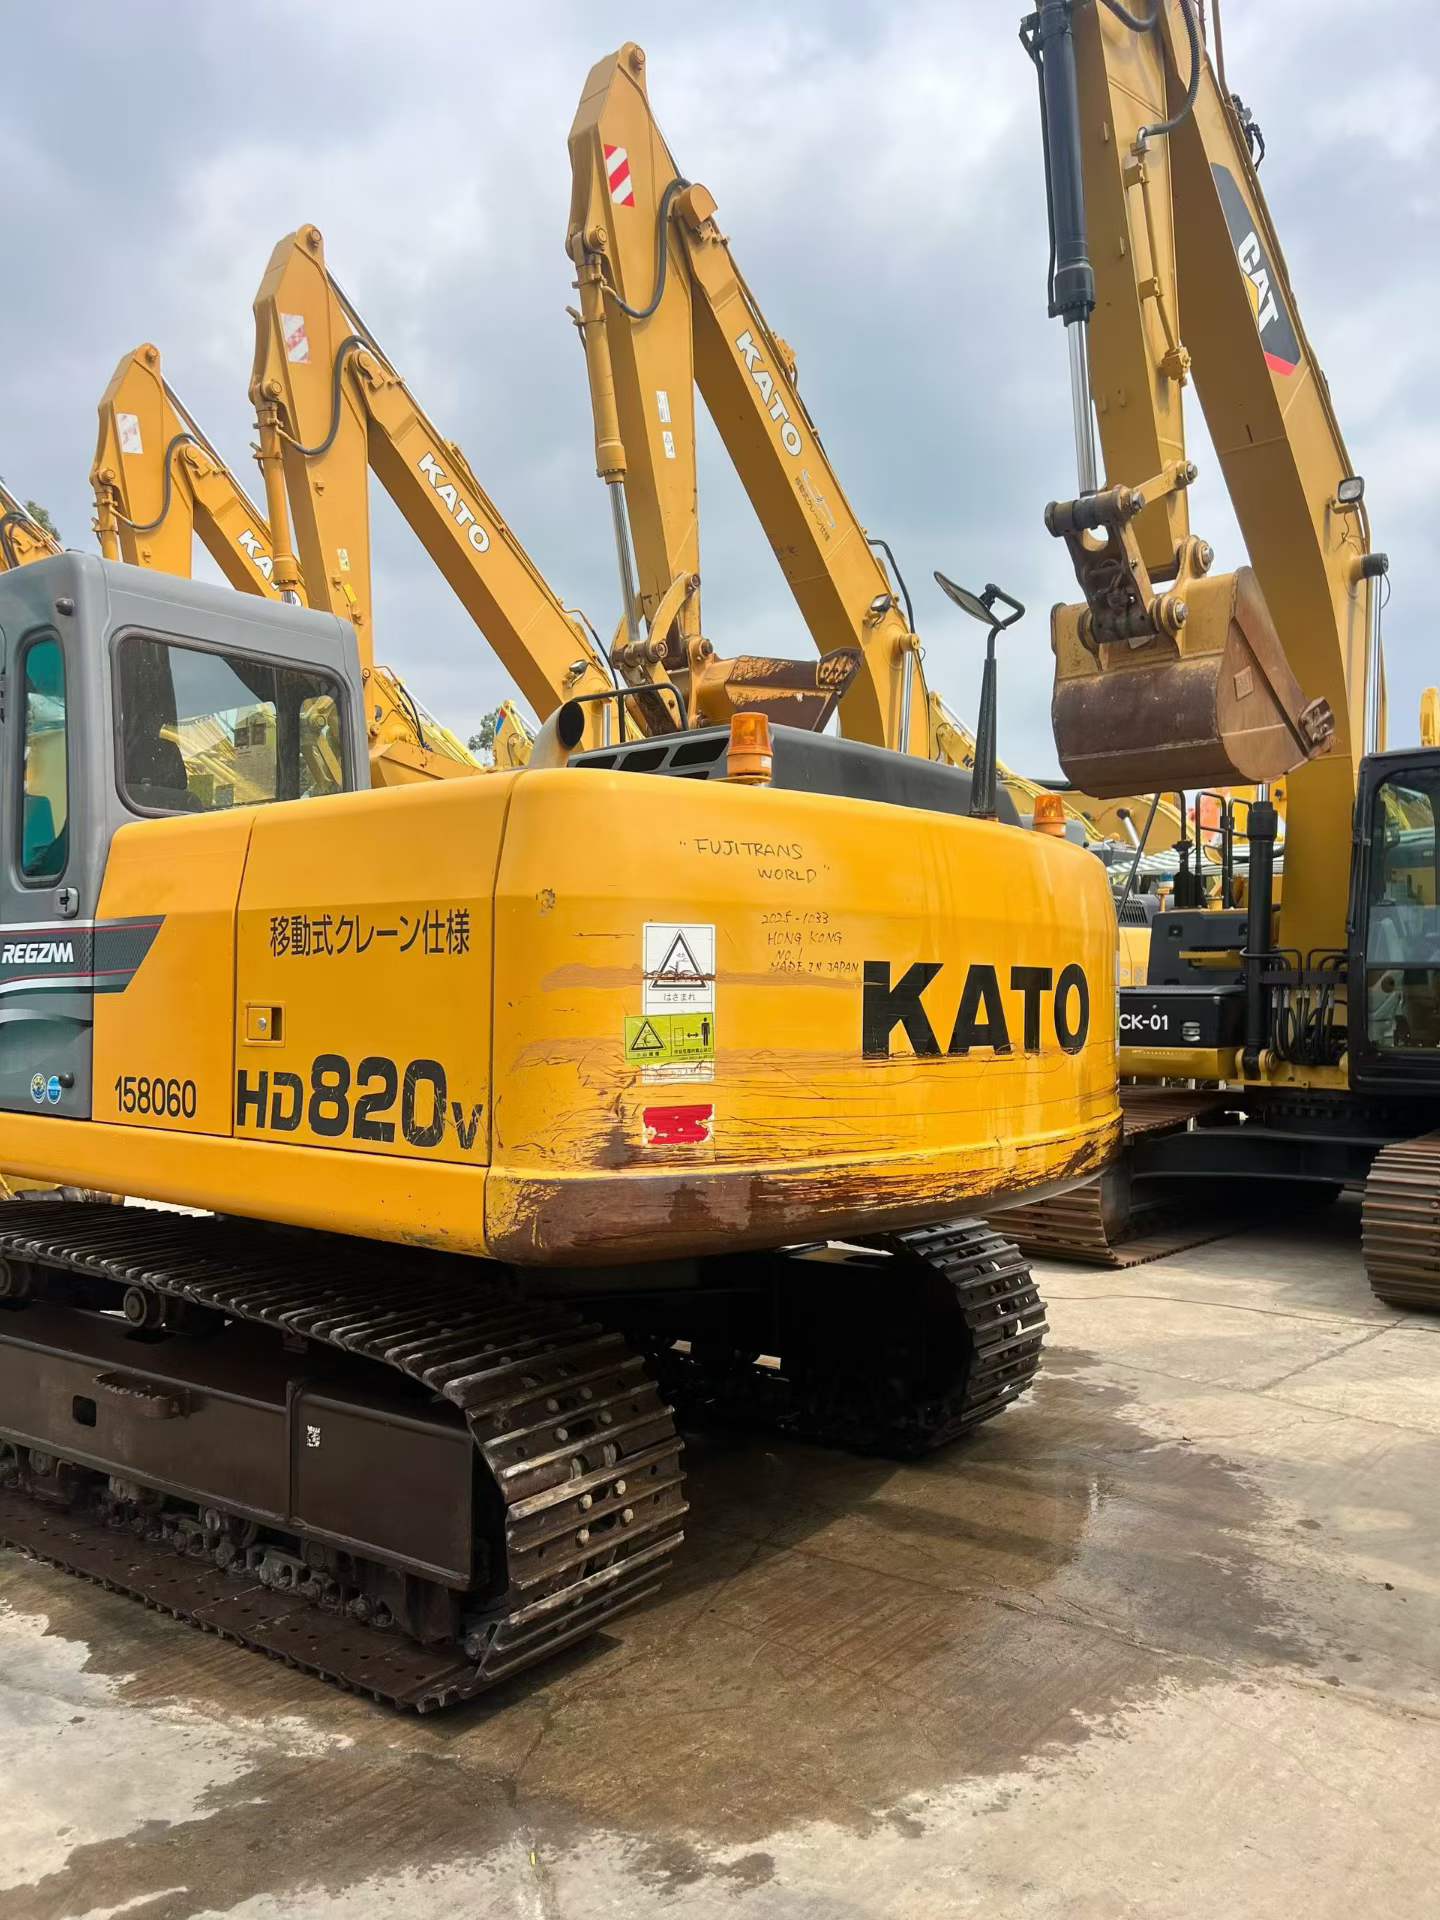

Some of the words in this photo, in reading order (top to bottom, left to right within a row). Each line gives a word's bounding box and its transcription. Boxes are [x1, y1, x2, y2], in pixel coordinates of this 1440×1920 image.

[1238, 231, 1279, 333] CAT
[736, 329, 802, 456] KATO
[417, 451, 490, 552] KATO
[269, 907, 471, 958] 移動式クレーン仕様
[767, 931, 802, 946] HONG
[810, 930, 842, 945] KONG
[808, 961, 823, 973] IN
[827, 961, 859, 973] JAPAN
[863, 961, 1090, 1060] KATO
[1119, 1014, 1168, 1030] CK-01
[115, 1075, 196, 1119] 158060
